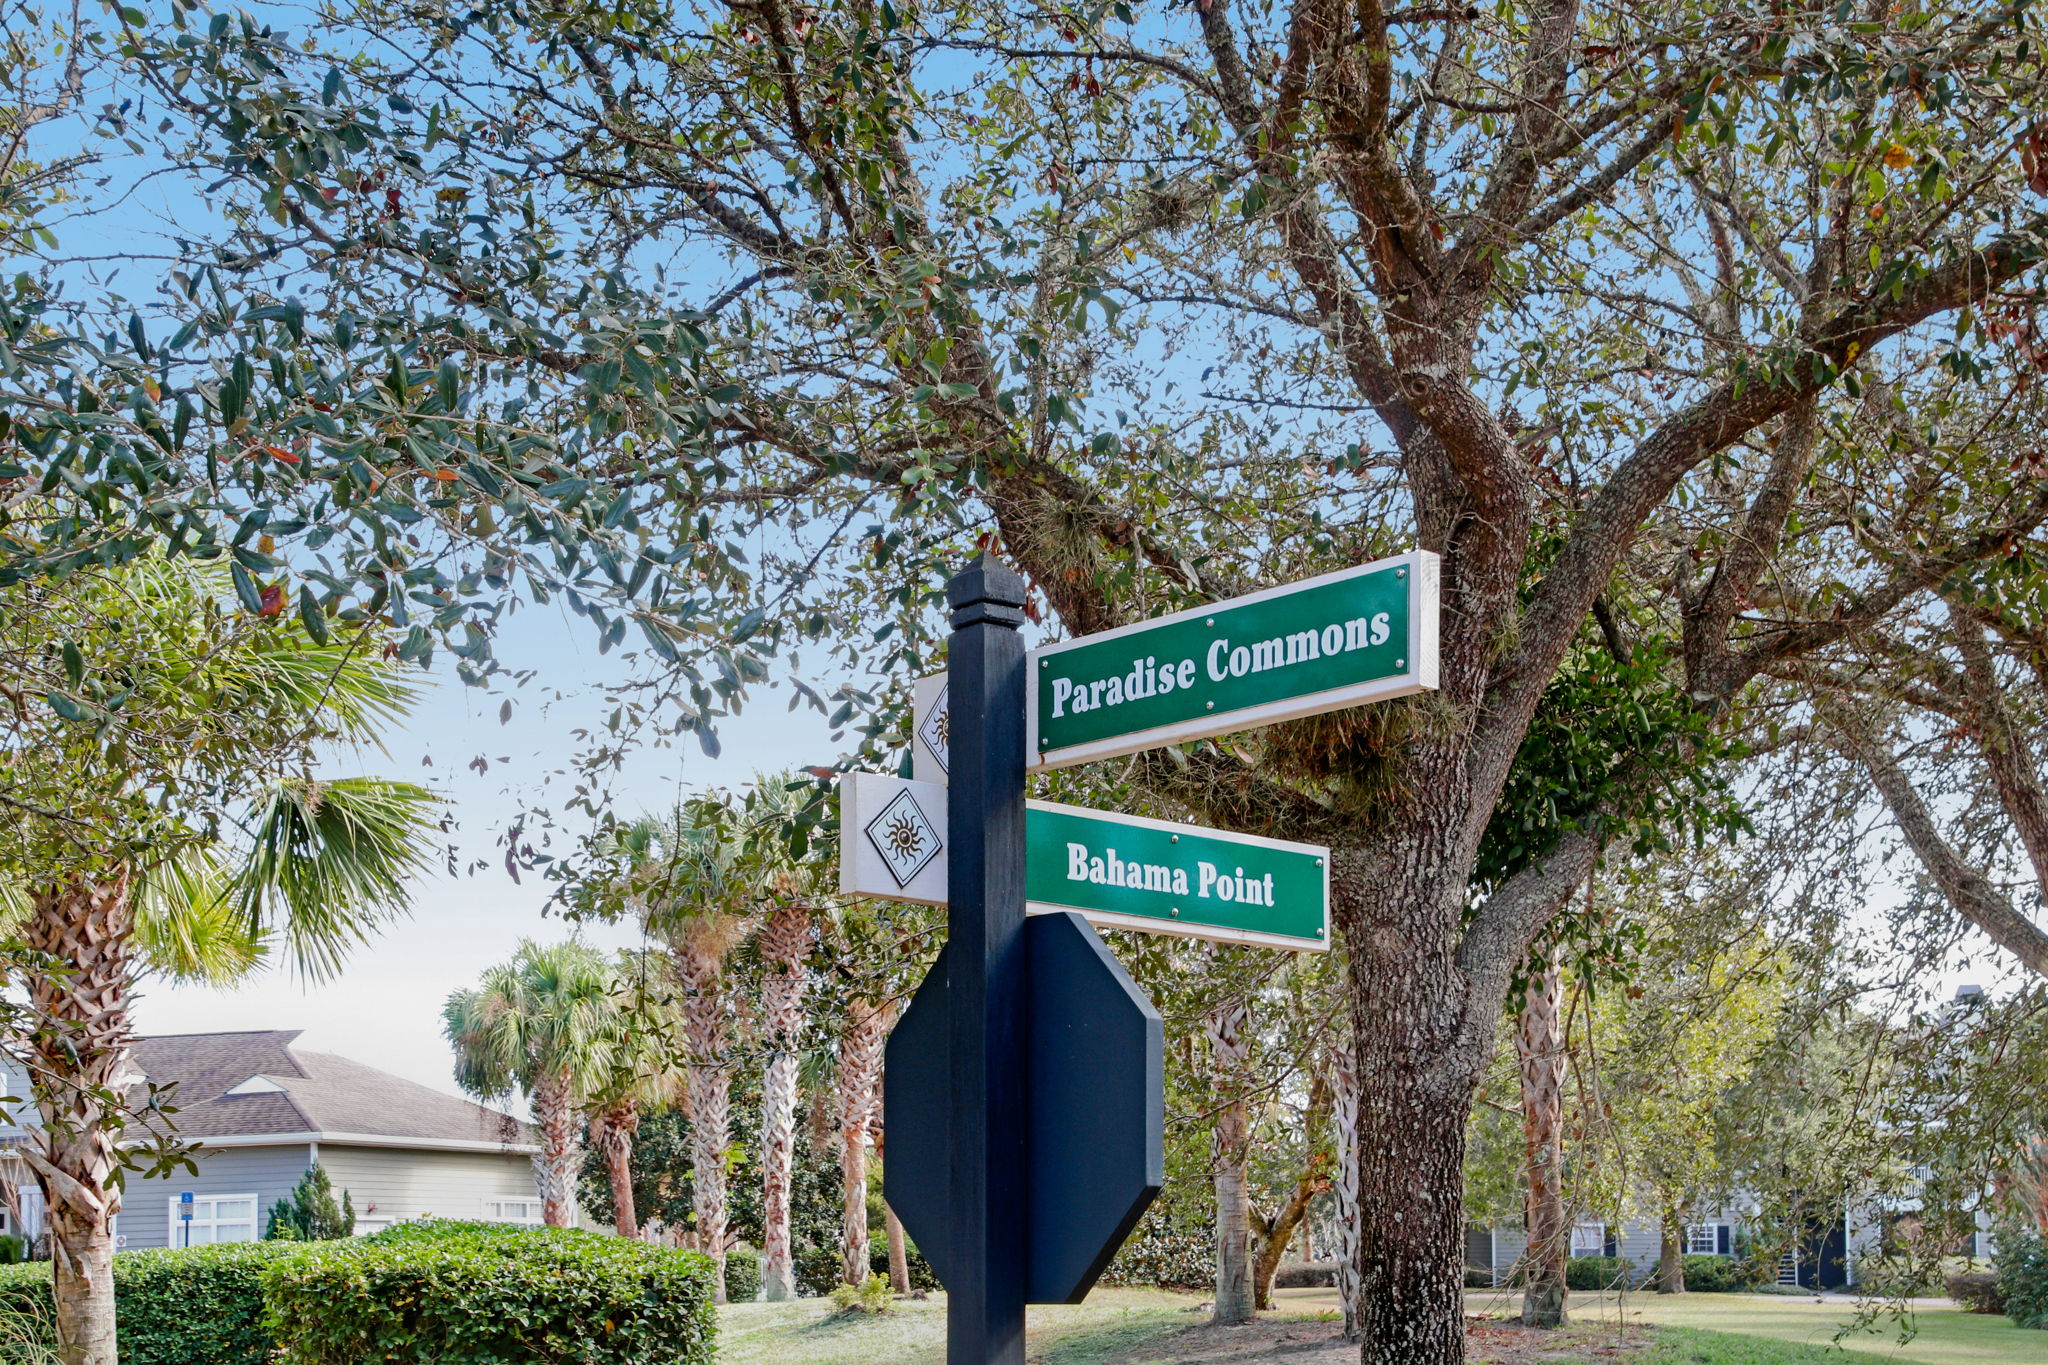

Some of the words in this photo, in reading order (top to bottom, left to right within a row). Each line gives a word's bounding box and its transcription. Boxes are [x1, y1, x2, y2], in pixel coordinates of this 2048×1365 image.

[1051, 655, 1196, 718] Paradise
[1206, 611, 1390, 682] Commons
[1067, 842, 1189, 896] Bahama
[1197, 861, 1275, 907] Point
